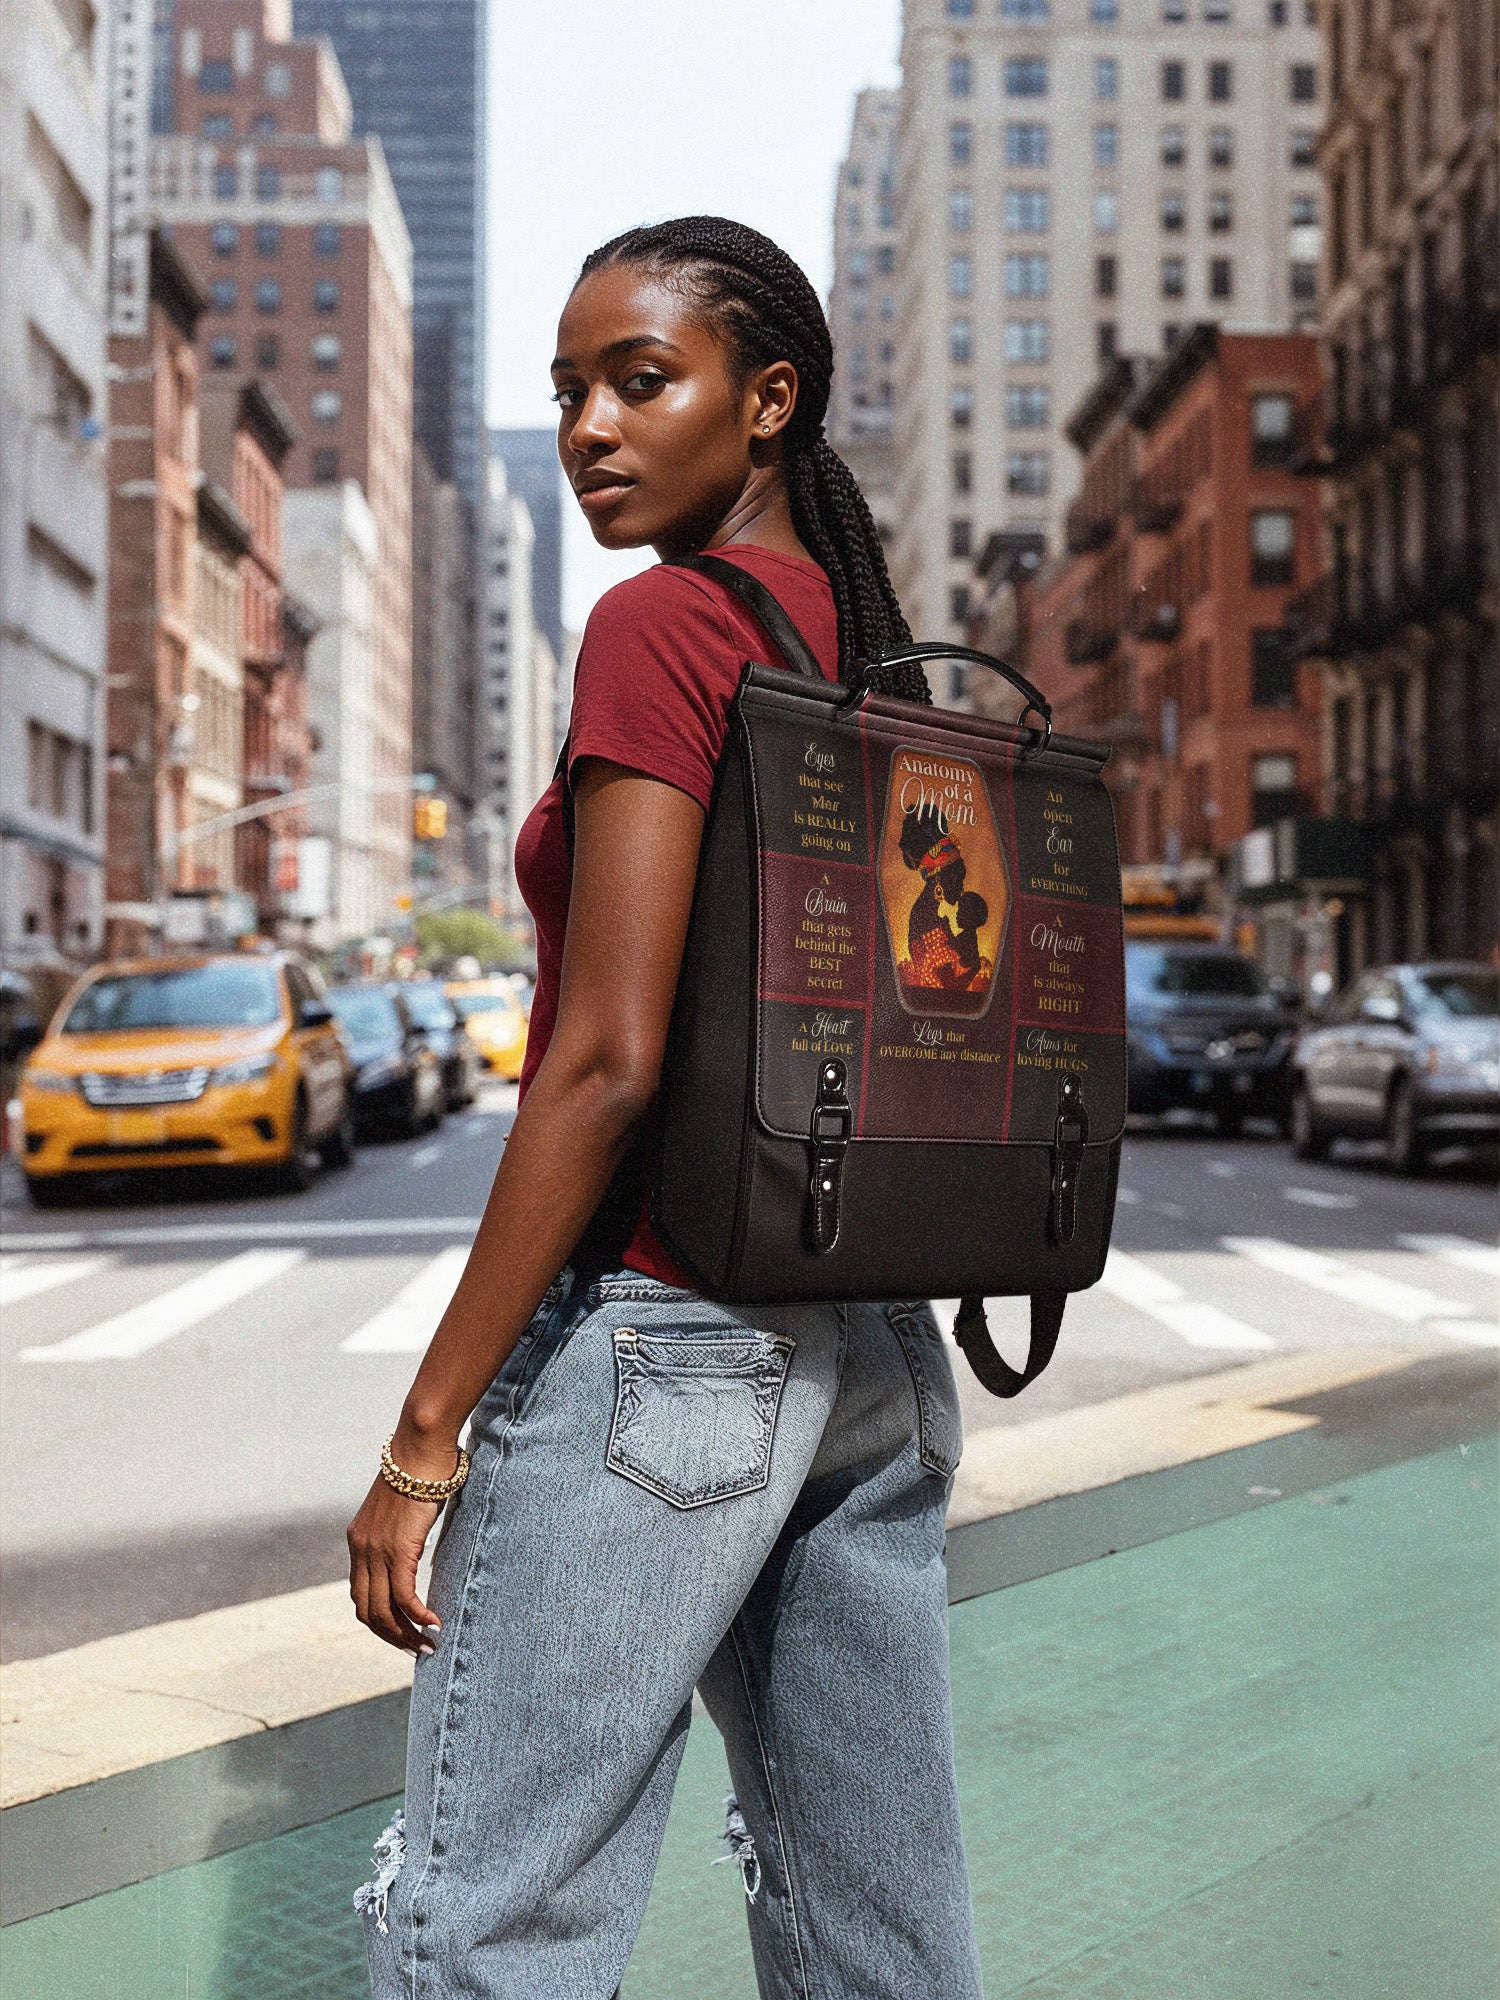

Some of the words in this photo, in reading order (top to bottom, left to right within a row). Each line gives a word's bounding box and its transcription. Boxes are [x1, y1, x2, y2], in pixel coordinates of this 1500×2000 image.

[804, 742, 836, 773] Eyes
[900, 755, 975, 784] Anatomy
[800, 774, 821, 789] that
[824, 780, 845, 793] see
[945, 784, 959, 799] of
[900, 776, 977, 836] Mom
[1046, 790, 1063, 804] An
[807, 813, 856, 833] REALLY
[1043, 808, 1073, 824] open
[801, 833, 834, 851] going
[837, 839, 851, 851] on
[1047, 826, 1074, 855] Ear
[1053, 862, 1070, 876] for
[821, 873, 830, 886] A
[1031, 877, 1089, 897] EVERYTHING
[805, 887, 848, 917] Brain
[802, 919, 824, 934] that
[827, 923, 852, 937] gets
[1053, 915, 1063, 928] A
[795, 935, 836, 953] behind
[839, 940, 857, 955] the
[1030, 923, 1085, 959] Mouth
[809, 956, 842, 972] BEST
[1049, 959, 1070, 975] that
[807, 976, 842, 990] secret
[1033, 974, 1043, 989] is
[1045, 977, 1085, 996] always
[1038, 996, 1082, 1015] RIGHT
[799, 1022, 808, 1033] A
[811, 1011, 854, 1042] Heart
[913, 1020, 945, 1047] Legs
[946, 1030, 965, 1044] that
[792, 1038, 809, 1052] full
[811, 1039, 821, 1053] of
[823, 1040, 854, 1056] LOVE
[1026, 1028, 1060, 1056] Arms
[1063, 1038, 1078, 1054] for
[879, 1045, 938, 1060] OVERCOME
[940, 1049, 958, 1063] any
[960, 1048, 1001, 1065] distance
[1017, 1051, 1052, 1072] loving
[1055, 1056, 1089, 1072] HUGS
